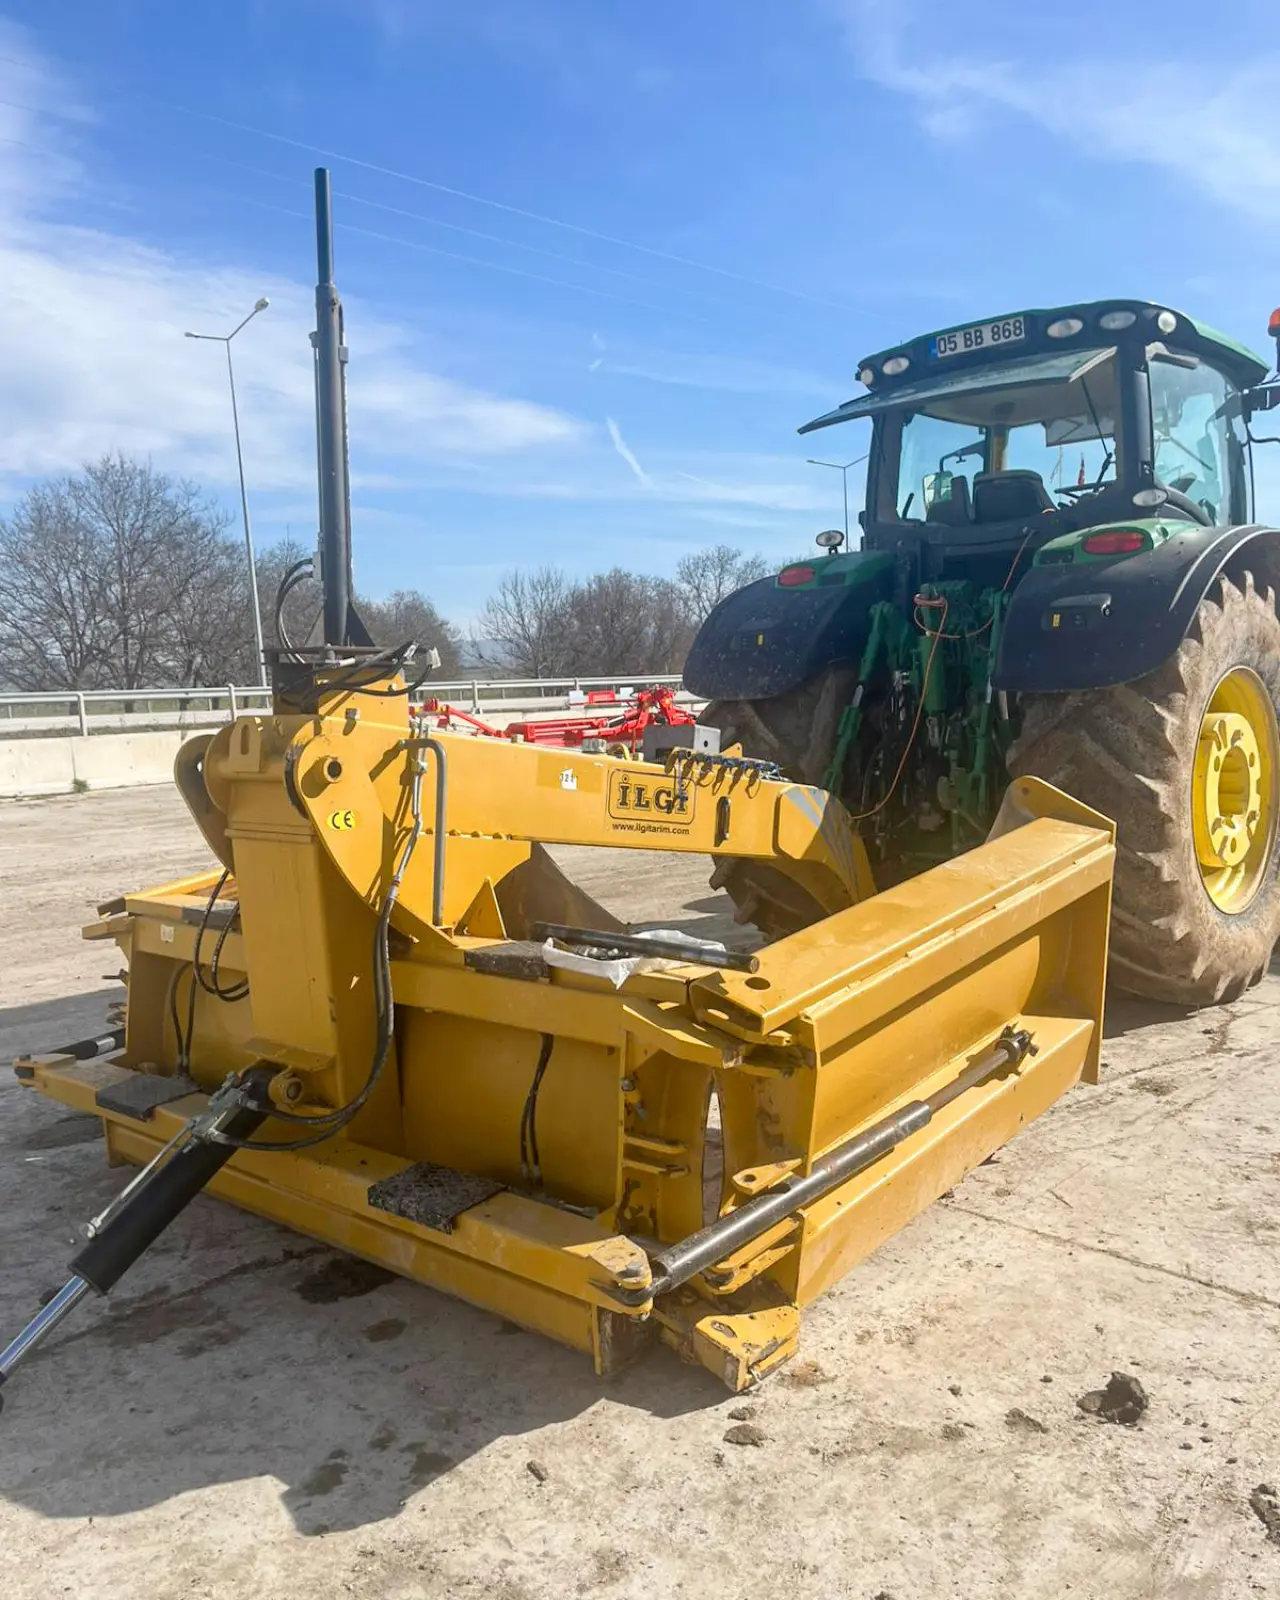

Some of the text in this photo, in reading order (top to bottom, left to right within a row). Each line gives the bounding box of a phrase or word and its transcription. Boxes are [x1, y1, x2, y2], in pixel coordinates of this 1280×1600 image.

[937, 334, 958, 355] 05
[963, 329, 984, 349] BB
[991, 319, 1023, 342] 868
[612, 822, 690, 835] www.ilgitarim.com
